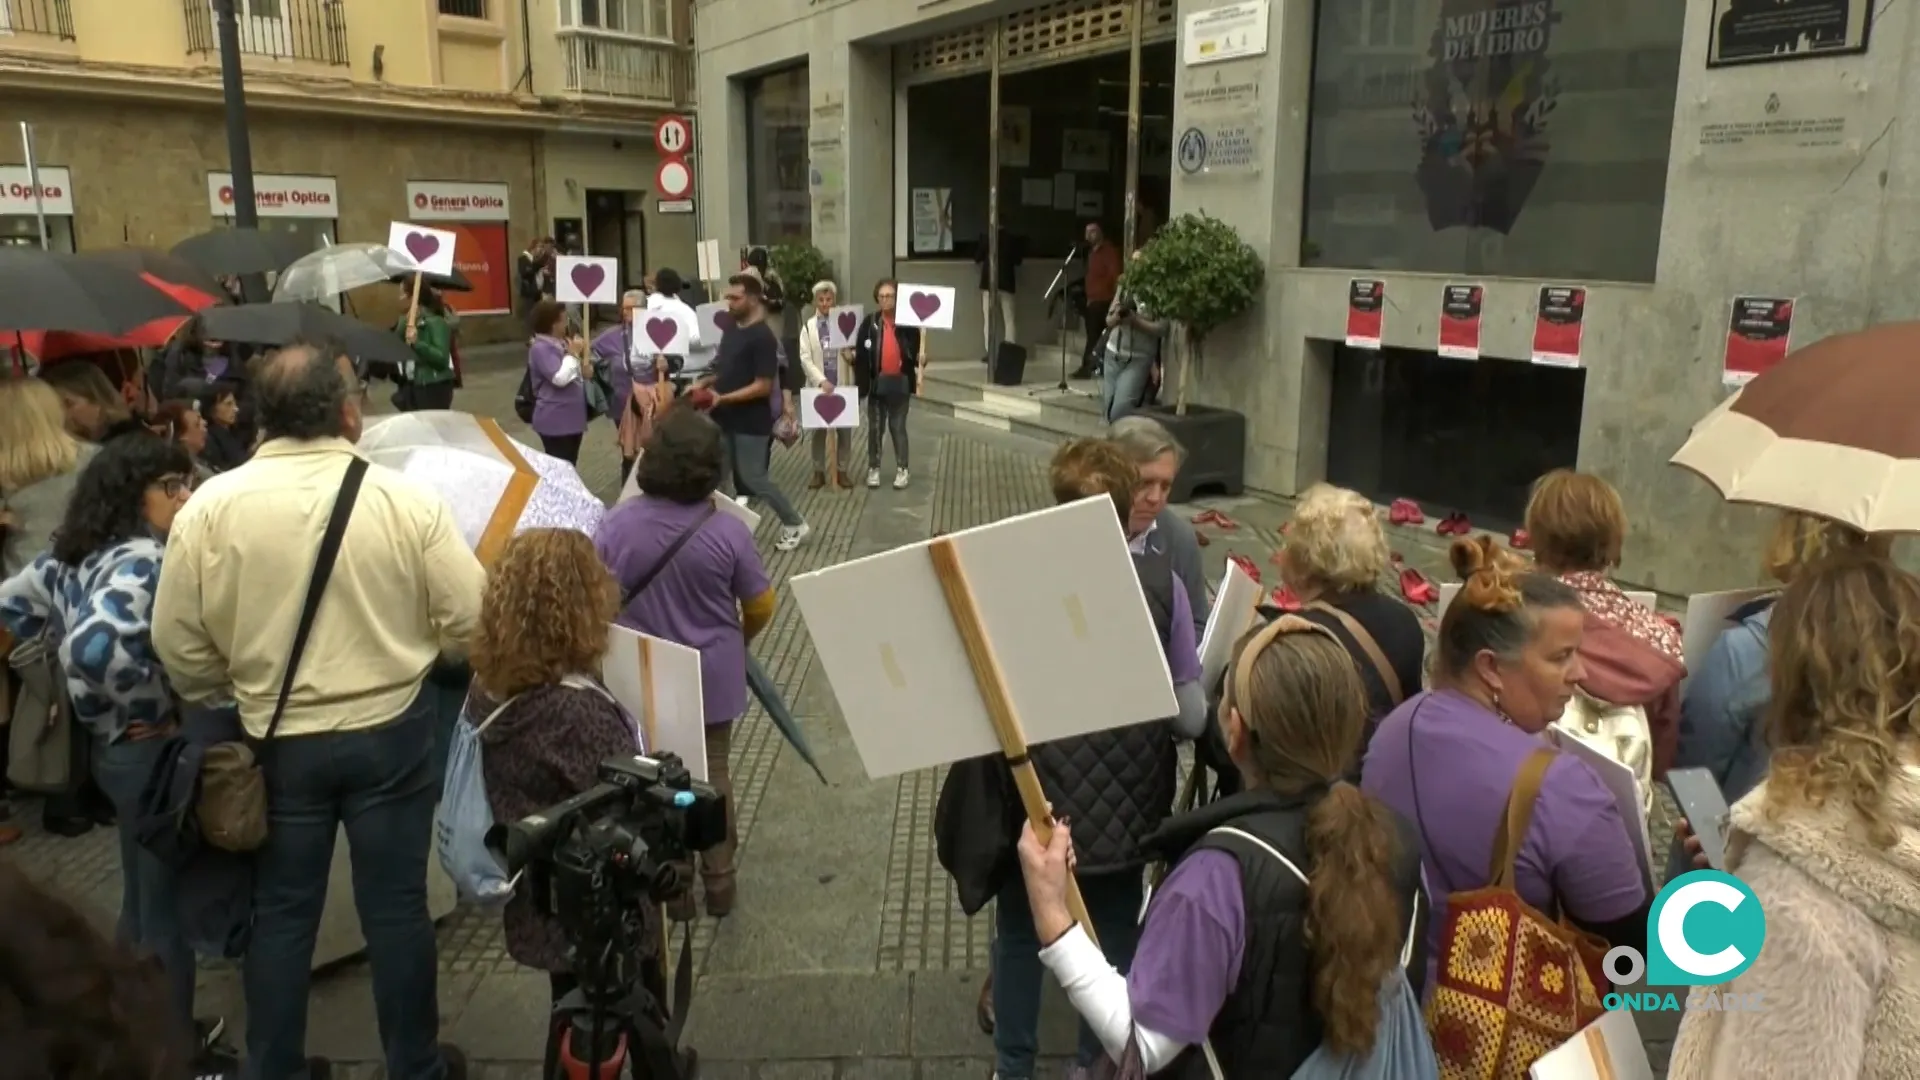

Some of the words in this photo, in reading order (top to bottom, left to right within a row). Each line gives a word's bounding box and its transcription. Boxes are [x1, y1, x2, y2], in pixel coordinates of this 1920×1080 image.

[1446, 1, 1546, 38] MUJERES
[10, 183, 62, 200] Opica
[291, 191, 330, 205] Optica
[431, 194, 470, 207] General
[472, 195, 504, 208] Optica
